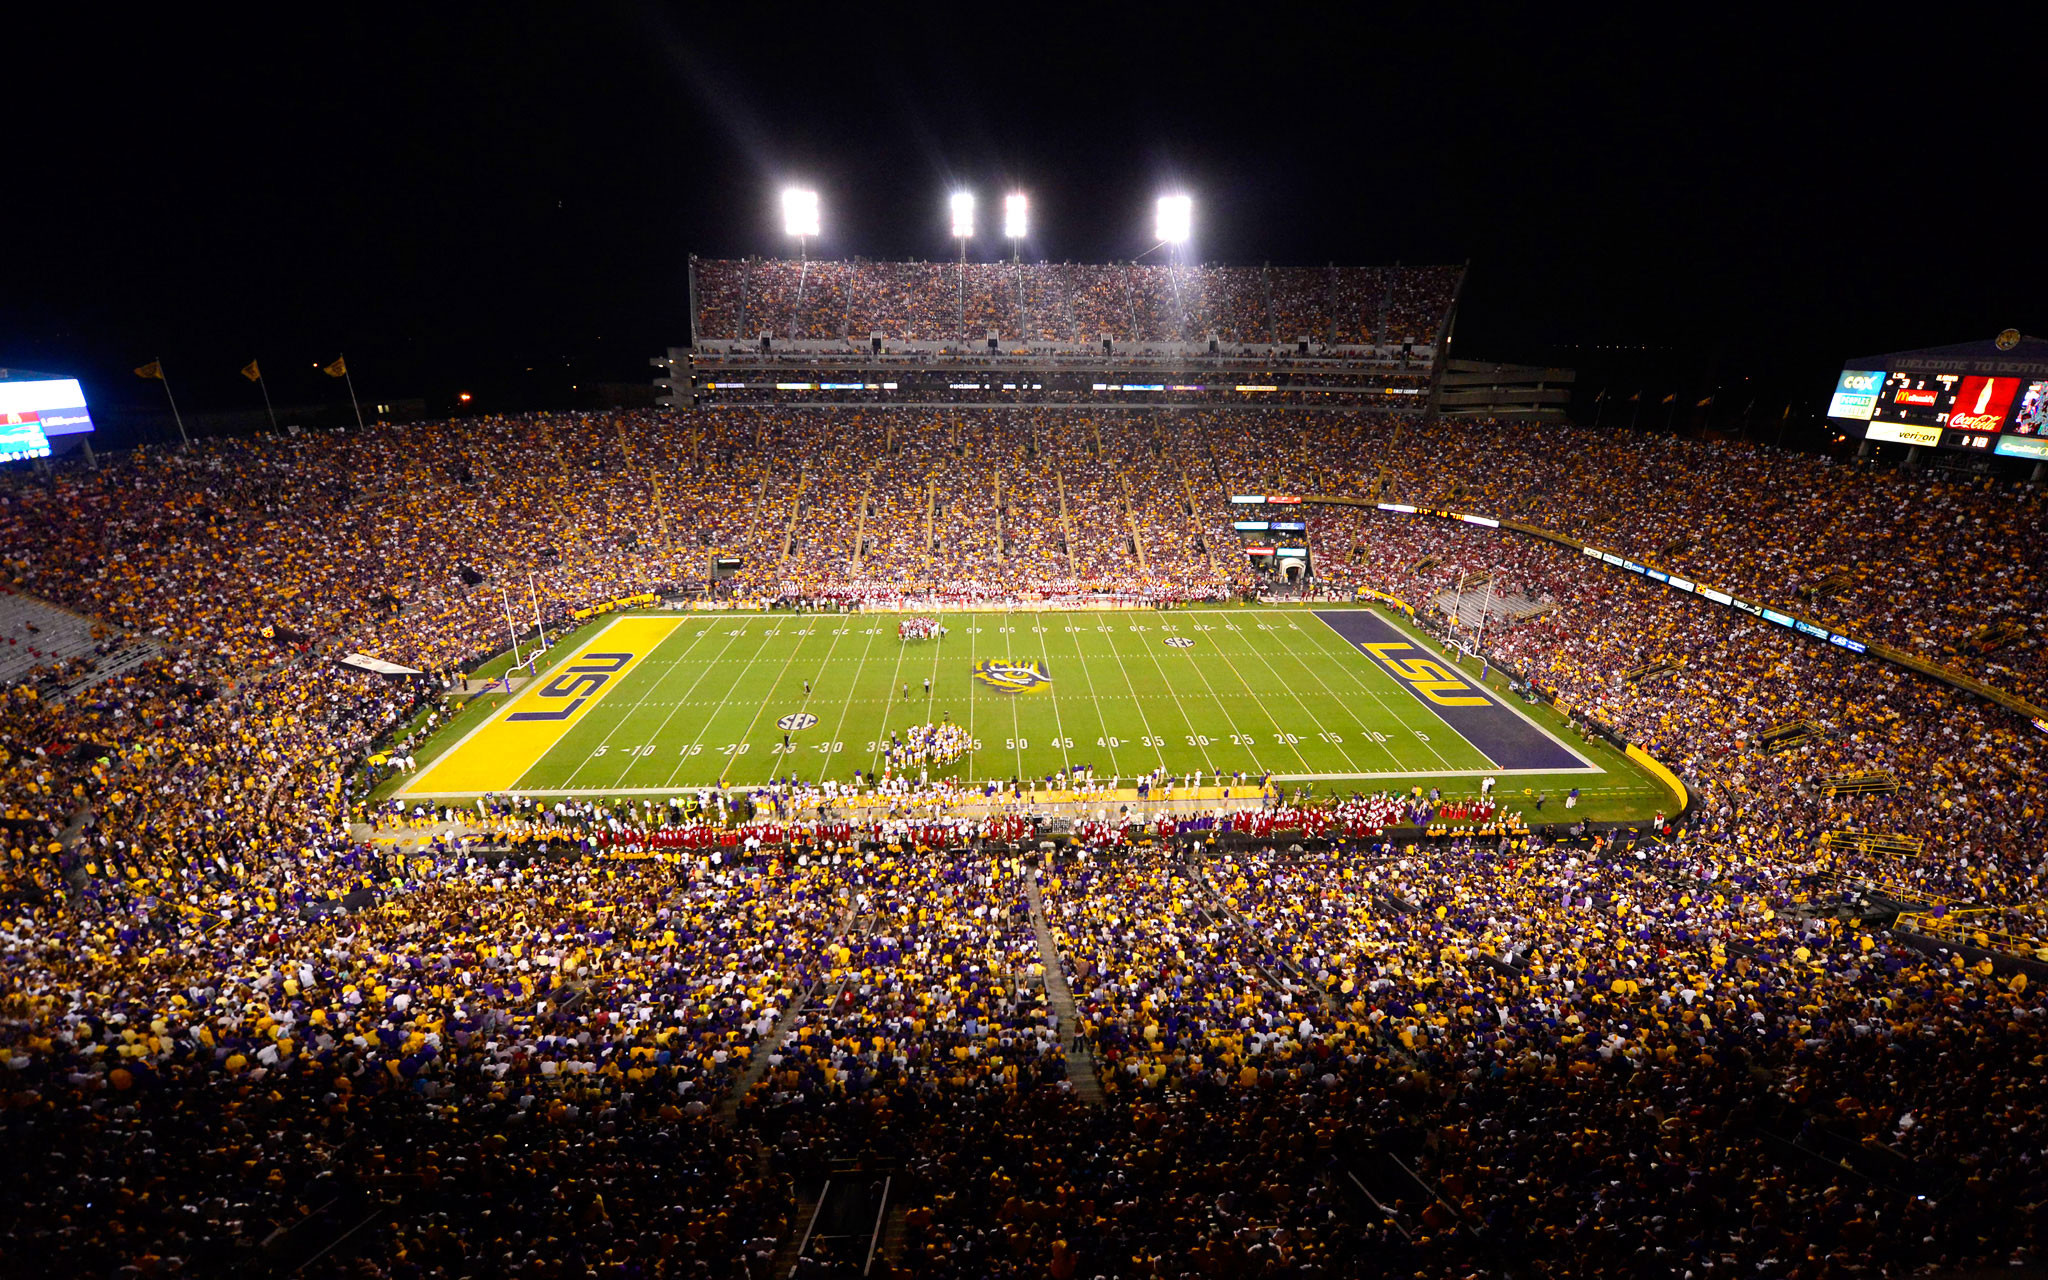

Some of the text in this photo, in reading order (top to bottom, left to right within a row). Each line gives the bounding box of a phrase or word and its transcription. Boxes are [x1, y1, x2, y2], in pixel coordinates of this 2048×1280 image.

[1896, 359, 1968, 370] WELCOME
[1974, 361, 1993, 371] TO
[1843, 375, 1878, 390] COX
[1899, 378, 1910, 389] 3
[1942, 381, 1952, 391] 7
[1840, 395, 1872, 406] PEOPLES
[1874, 407, 1881, 416] 3
[1900, 409, 1908, 418] 4
[1936, 413, 1950, 424] 37
[1899, 431, 1937, 442] verizon
[1163, 637, 1195, 648] SEC
[1360, 642, 1494, 707] LSU
[504, 652, 634, 722] LSU
[777, 713, 818, 730] SEC
[1141, 735, 1165, 747] 35
[1185, 735, 1209, 746] 30
[1230, 734, 1254, 745] 25
[1274, 733, 1298, 744] 20
[1318, 732, 1343, 743] 15
[1361, 731, 1387, 742] 10
[1415, 730, 1430, 741] 5
[819, 741, 843, 753] 30
[866, 741, 890, 752] 35
[1006, 738, 1028, 749] 50
[1051, 737, 1074, 749] 45
[1097, 736, 1119, 748] 40
[594, 745, 610, 757] 5
[630, 745, 657, 757] 10
[679, 744, 703, 756] 15
[723, 743, 750, 755] 20
[771, 742, 798, 754] 25
